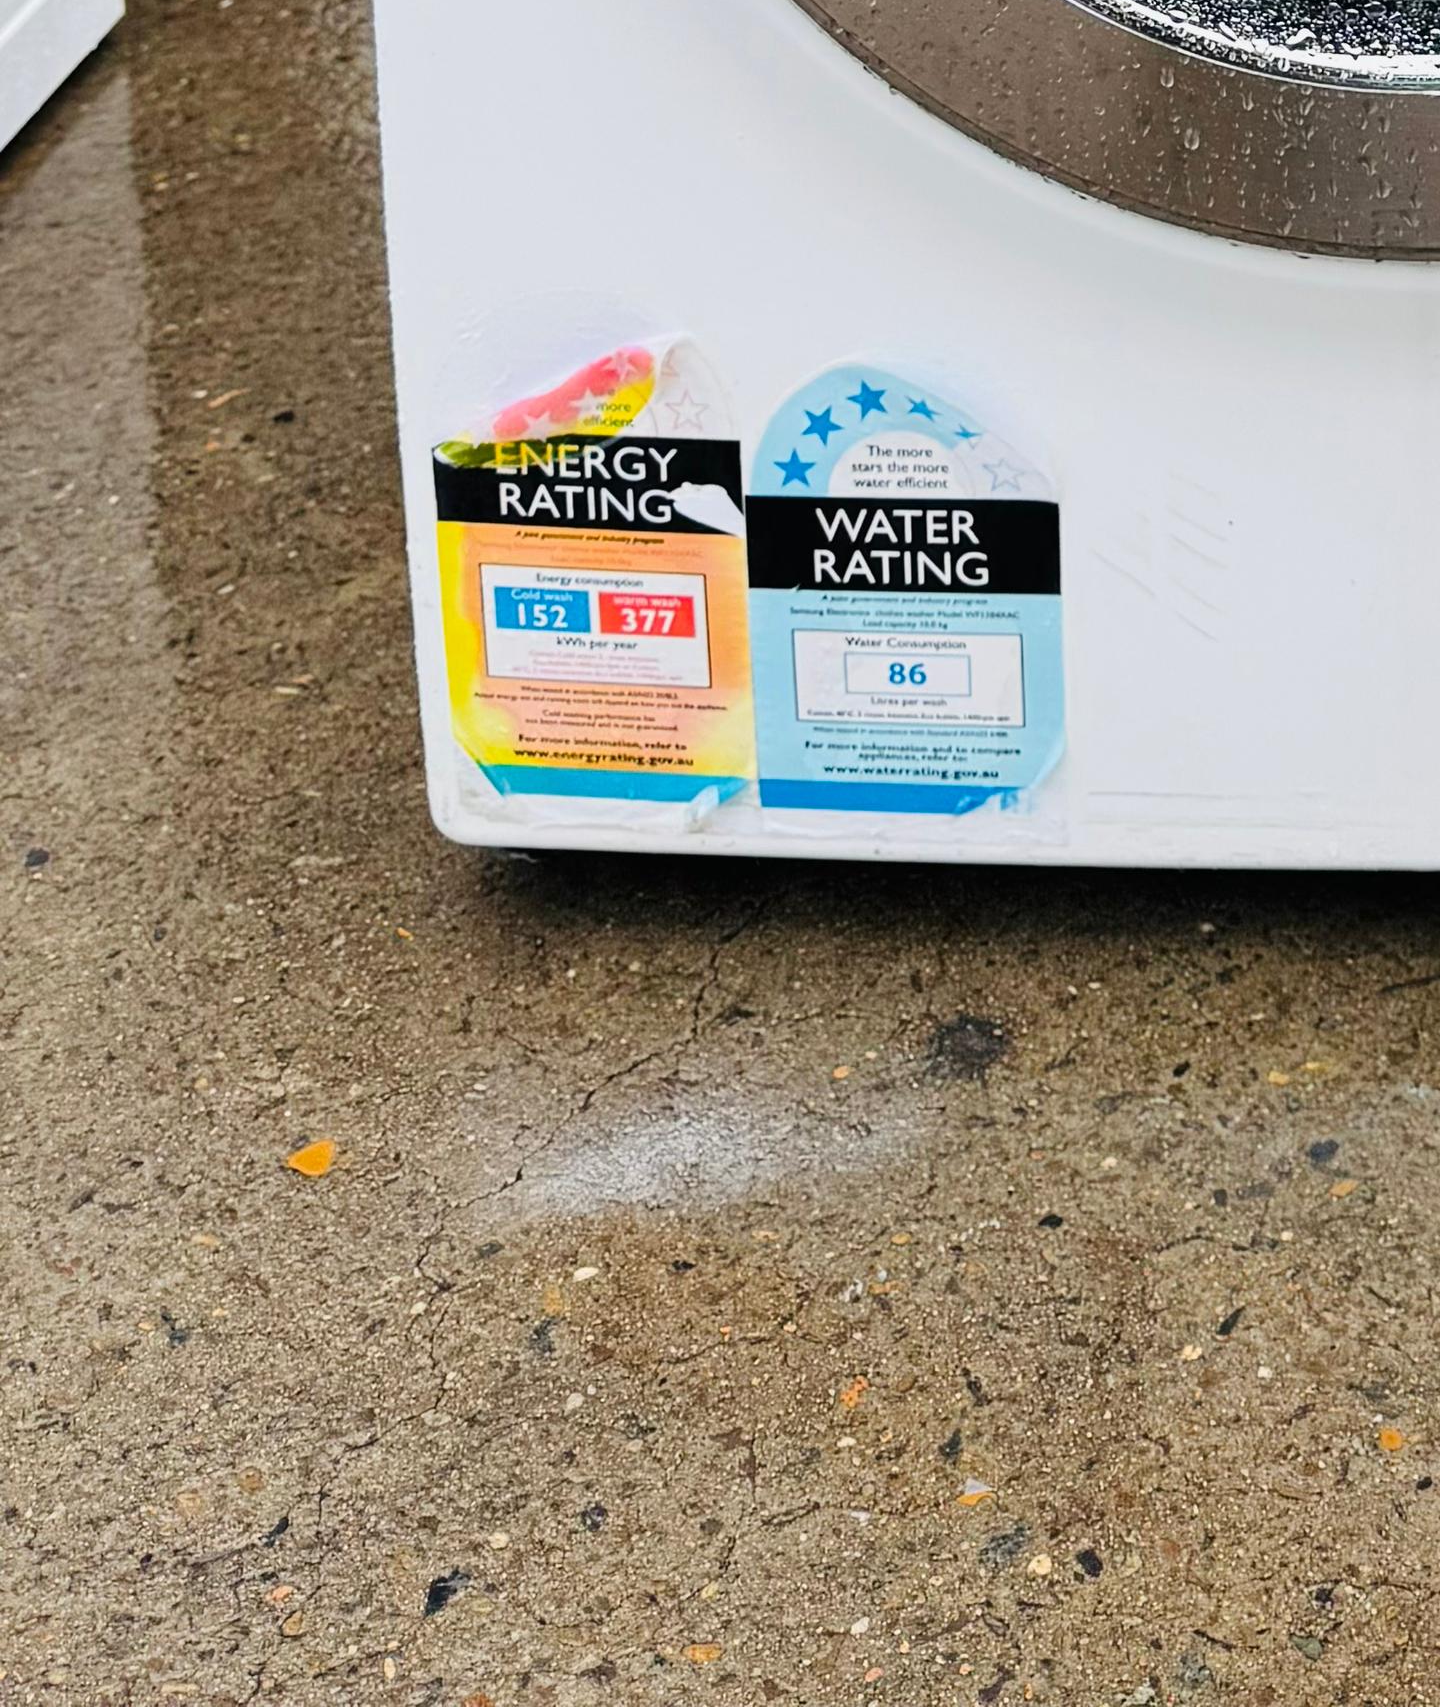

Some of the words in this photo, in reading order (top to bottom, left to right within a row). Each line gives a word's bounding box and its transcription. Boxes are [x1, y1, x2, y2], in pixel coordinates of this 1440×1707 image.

[866, 444, 893, 457] The
[897, 448, 933, 458] more
[494, 441, 678, 483] ENERGY
[851, 463, 882, 473] stars
[887, 461, 909, 473] the
[912, 463, 950, 473] more
[854, 477, 891, 488] water
[896, 476, 949, 489] efficient
[498, 482, 673, 525] RATING
[814, 507, 981, 545] WATER
[813, 548, 990, 587] RATING
[536, 572, 573, 587] Energy
[575, 576, 645, 588] consumption
[510, 588, 541, 601] Cold
[517, 602, 570, 629] 152
[620, 607, 677, 634] 377
[556, 636, 586, 647] kWh
[589, 639, 609, 650] per
[613, 640, 639, 651] year
[845, 636, 883, 647] Water
[886, 637, 968, 651] Consumption
[889, 662, 928, 685] 86
[518, 733, 538, 743] For
[540, 736, 571, 745] more
[644, 740, 673, 750] refer
[675, 742, 688, 751] to
[513, 749, 695, 767] www.energyrating.gov.au
[824, 765, 1001, 780] www.waterrating.gov.au
